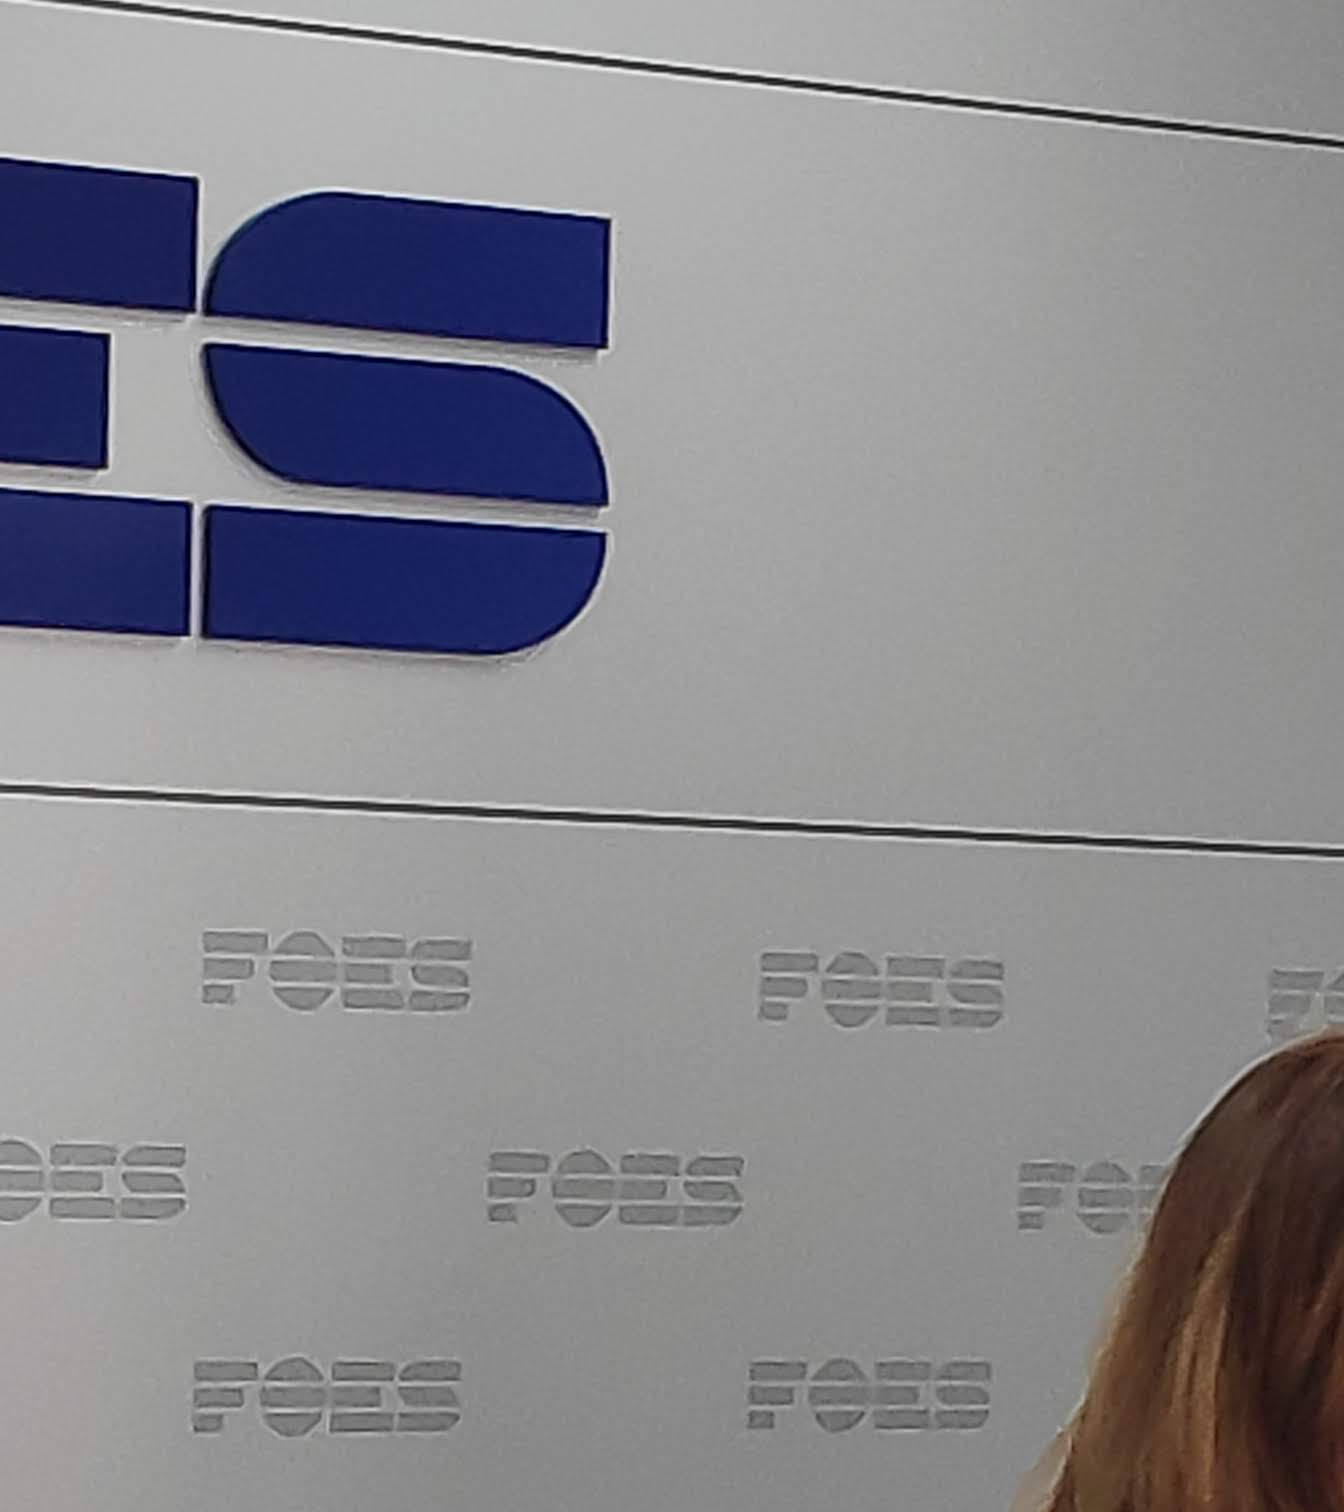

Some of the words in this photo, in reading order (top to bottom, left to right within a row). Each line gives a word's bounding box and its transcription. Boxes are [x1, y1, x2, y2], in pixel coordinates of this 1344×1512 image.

[201, 928, 472, 1013] FOES
[759, 950, 1004, 1027] FOES
[487, 1149, 743, 1228] FOES
[191, 1355, 463, 1435] FOES
[746, 1357, 992, 1432] FOES
